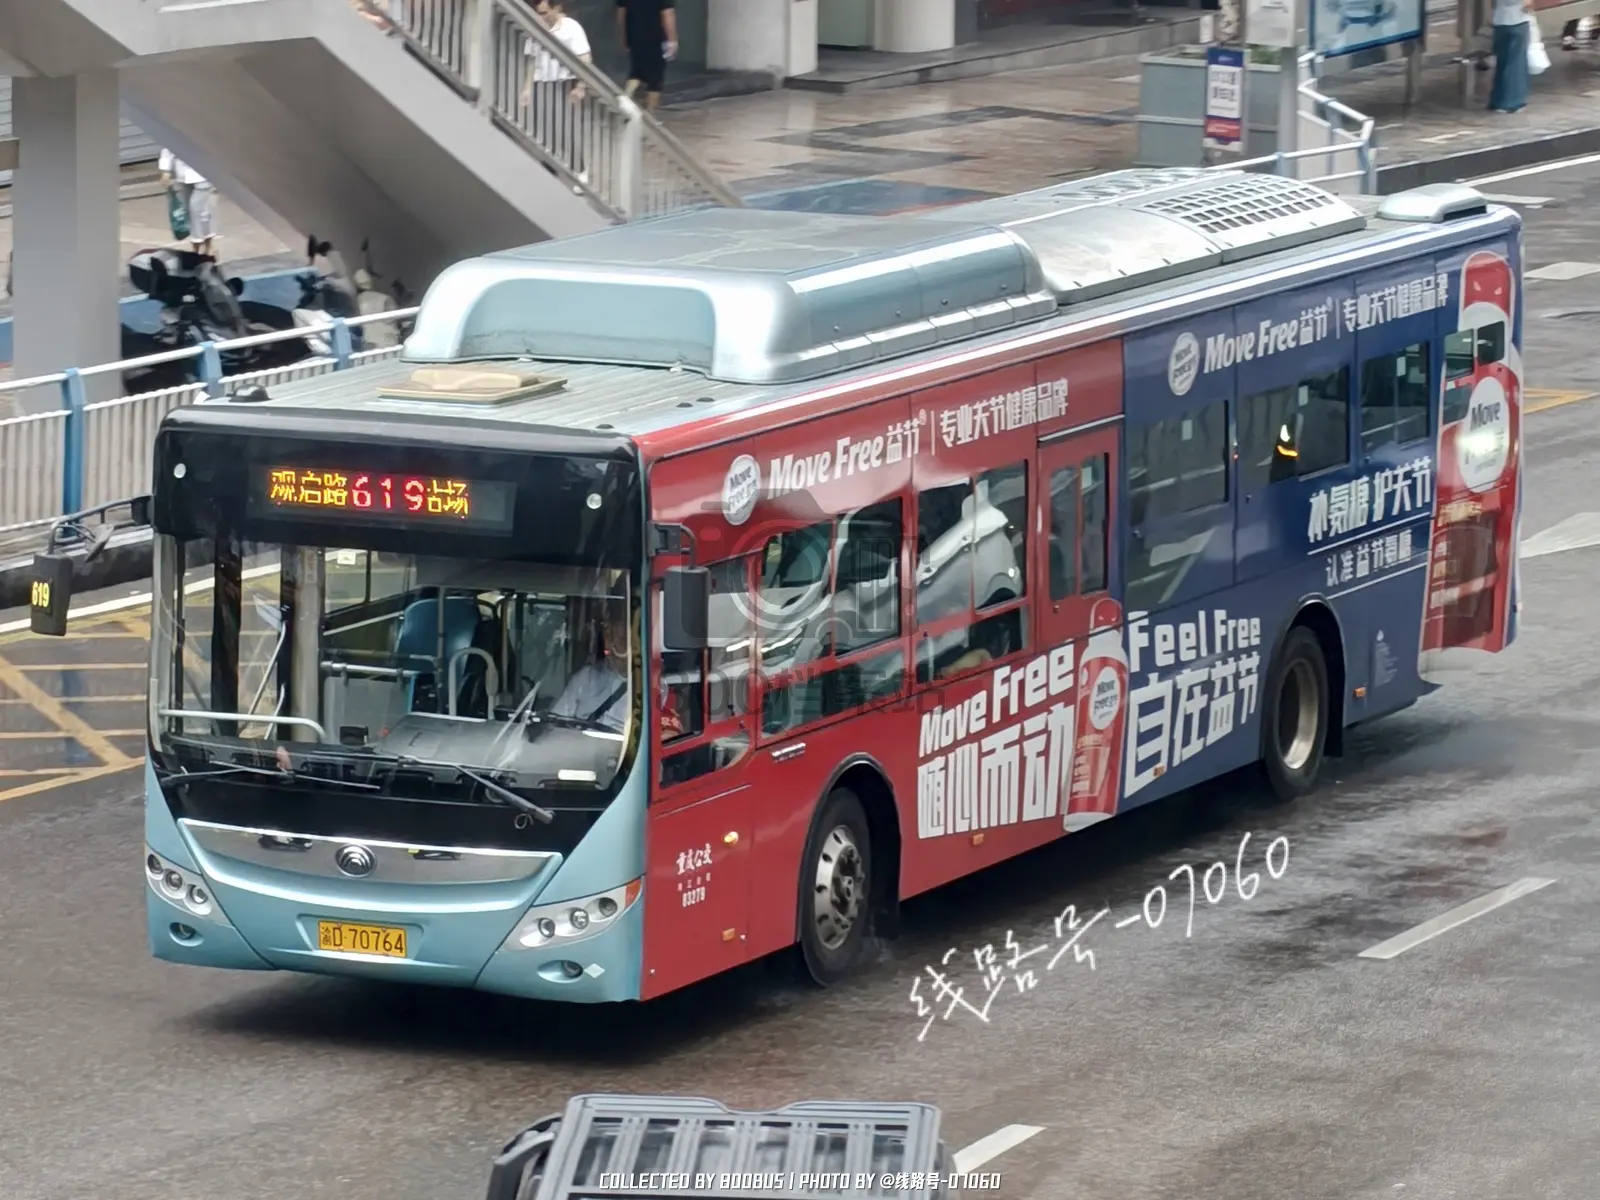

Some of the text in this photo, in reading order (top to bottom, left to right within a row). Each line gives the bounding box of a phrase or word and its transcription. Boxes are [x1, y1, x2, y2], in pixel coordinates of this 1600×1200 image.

[1204, 331, 1255, 373] Move
[1259, 317, 1298, 358] Free
[768, 450, 831, 499] Move
[834, 436, 883, 480] Free
[940, 379, 1068, 448] 专业关节健康品牌
[351, 474, 425, 511] 619
[32, 581, 50, 608] 619
[1127, 609, 1261, 674] Feel Free
[919, 638, 1074, 758] Move Free
[1124, 652, 1261, 799] 自在益节
[917, 701, 1075, 839] 随心而动
